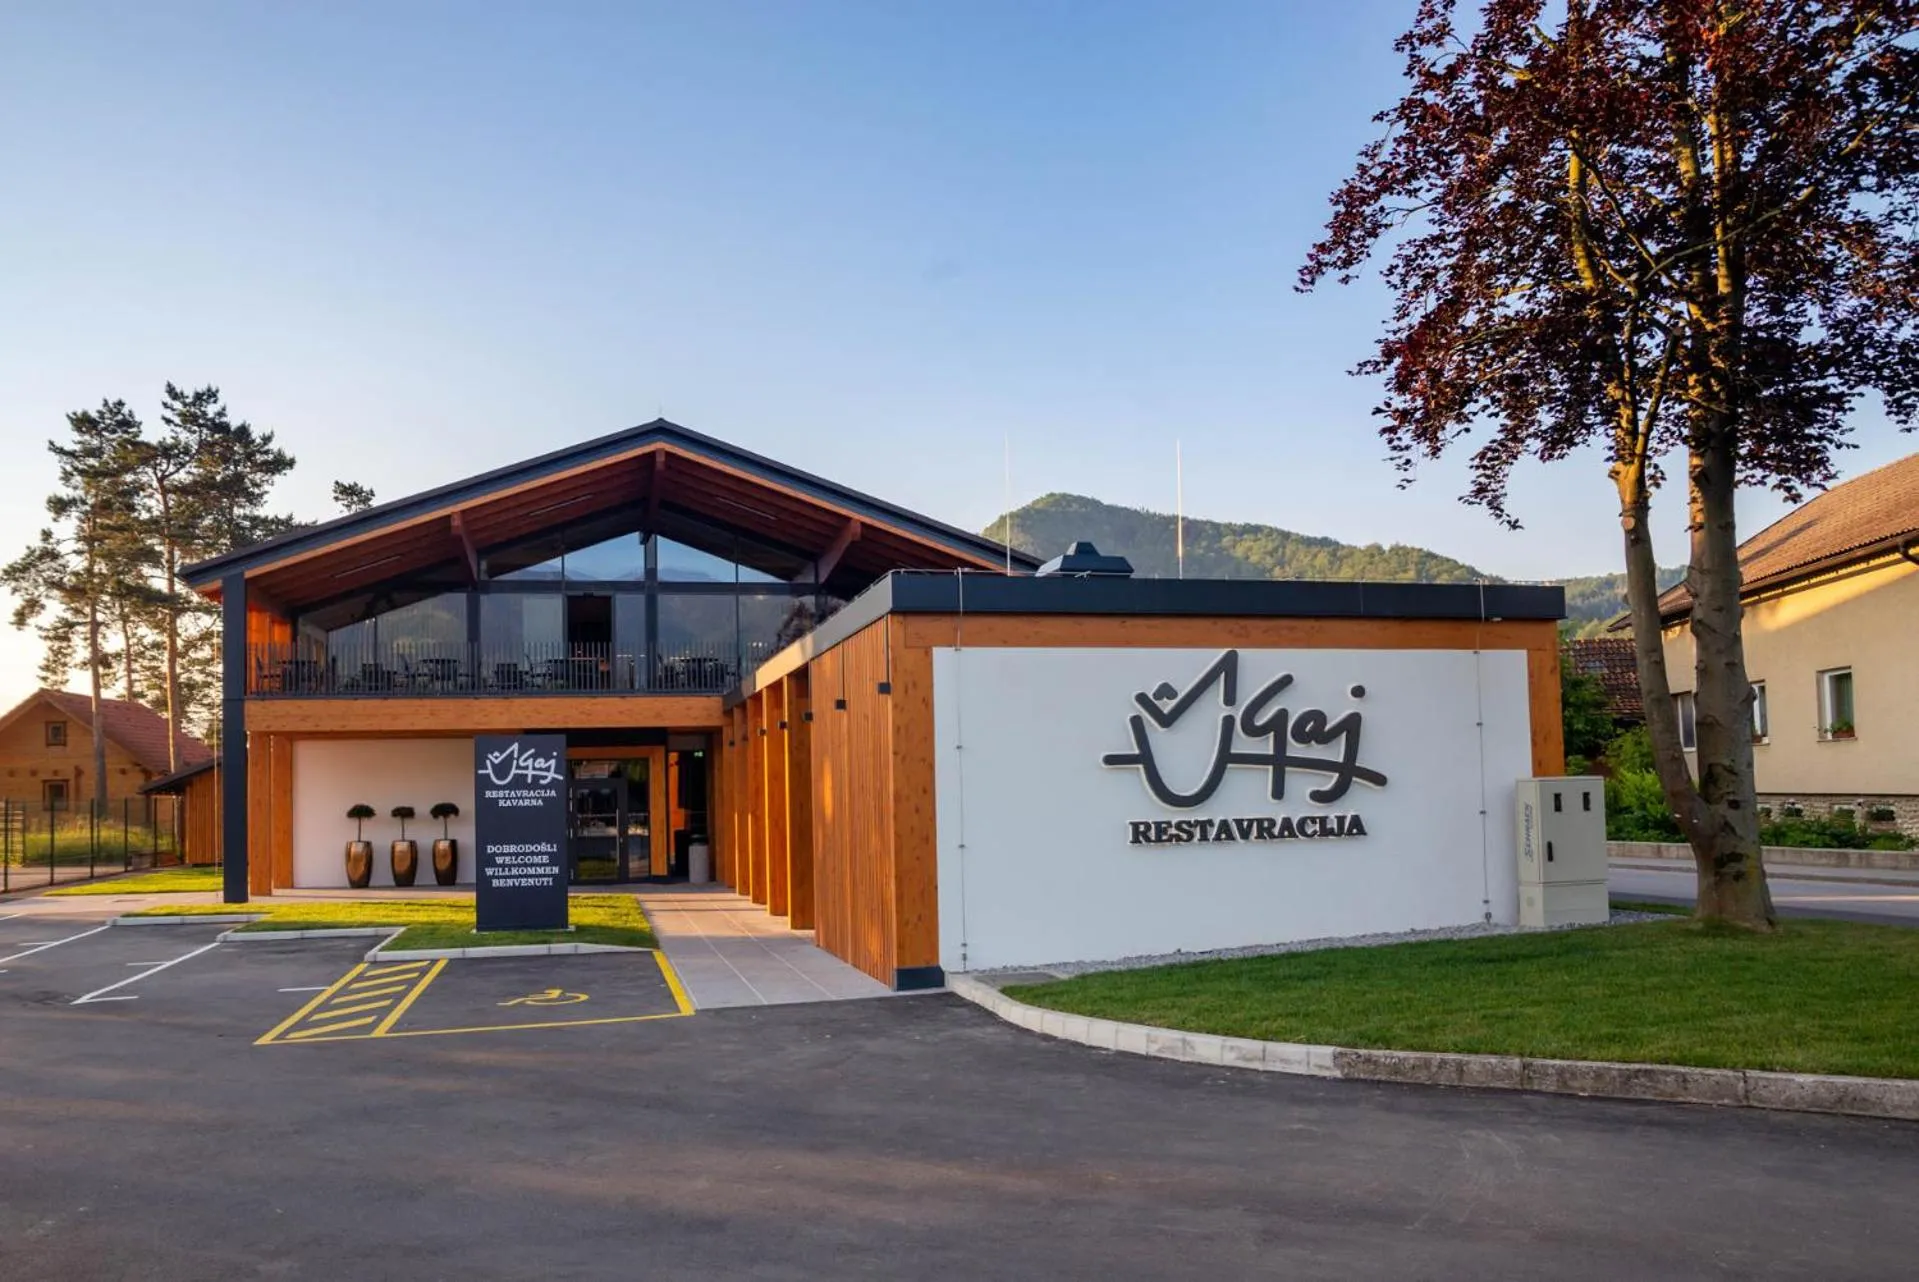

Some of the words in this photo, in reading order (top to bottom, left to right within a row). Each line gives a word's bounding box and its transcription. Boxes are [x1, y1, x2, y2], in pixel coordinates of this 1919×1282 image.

[485, 789, 557, 798] RESTAVRACIJA
[498, 798, 543, 807] KAVARNA
[1129, 815, 1368, 844] RESTAVRACIJA
[486, 842, 557, 854] DOBRODOŠLI
[495, 855, 549, 865] WELCOME
[485, 866, 559, 876] WILLKOMMEN
[492, 877, 553, 888] BENVENUTI
